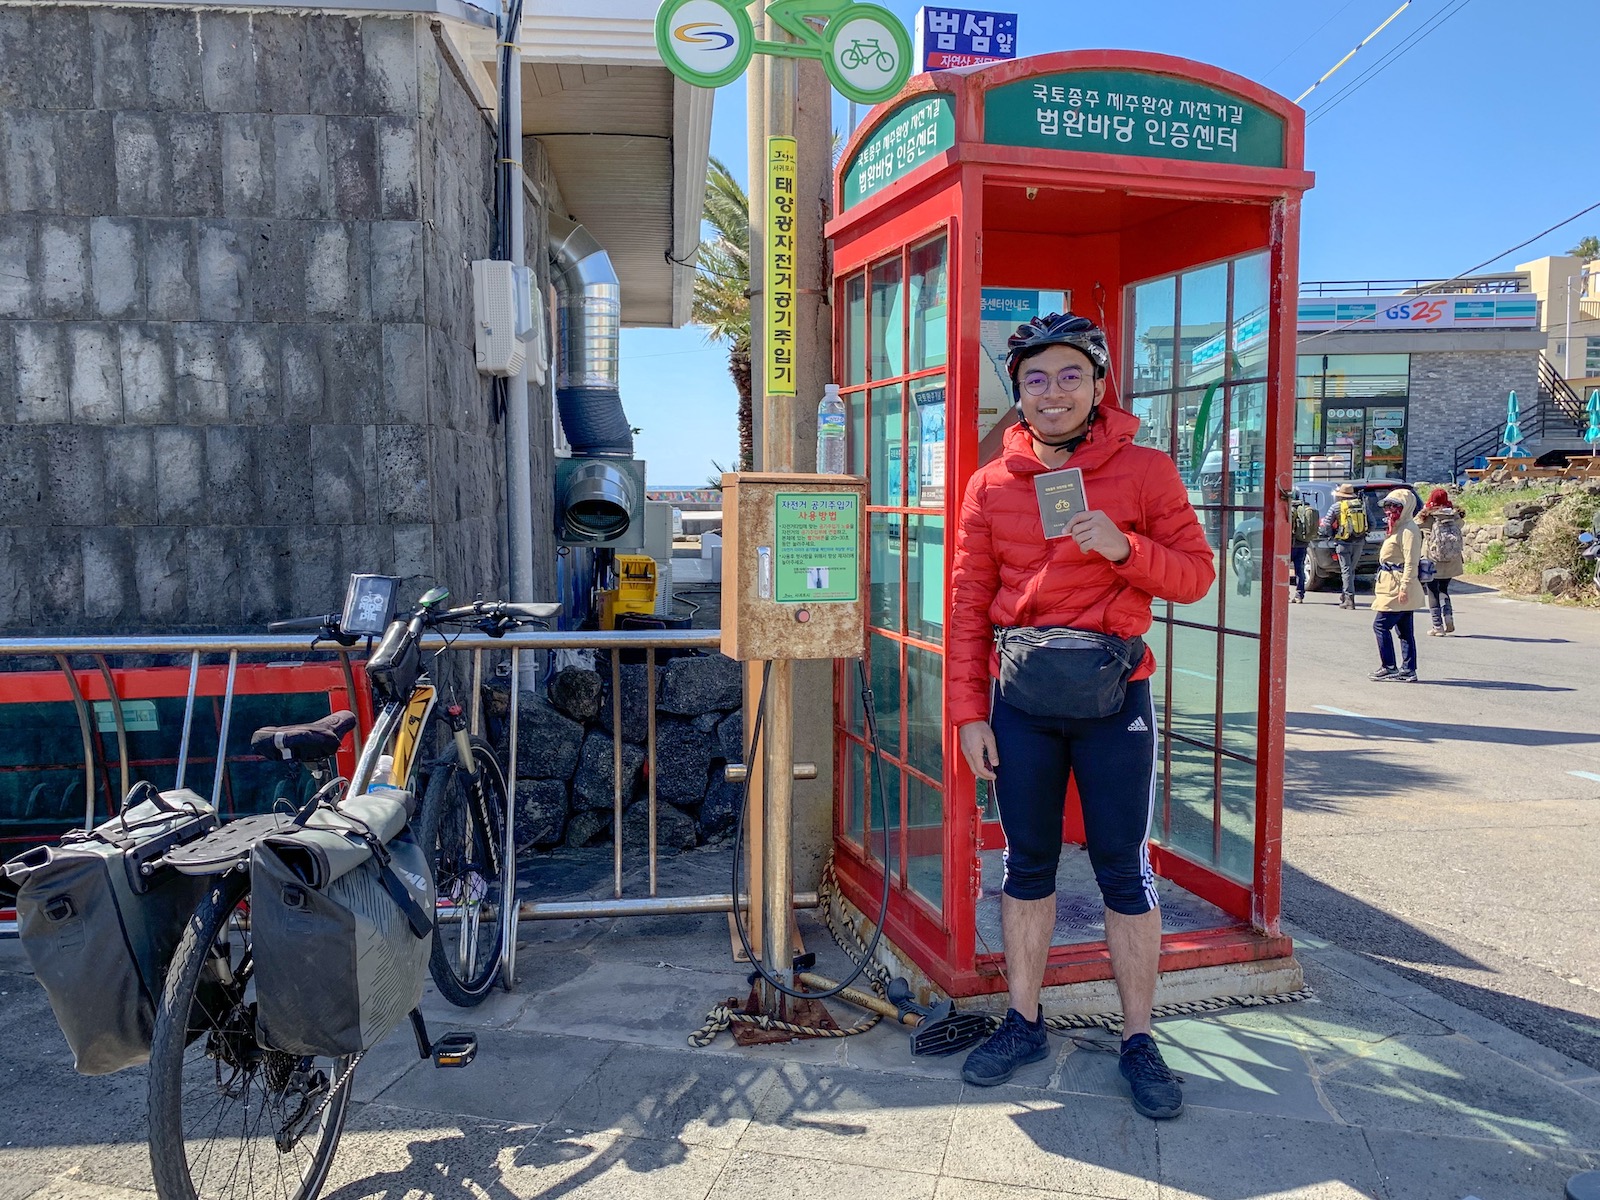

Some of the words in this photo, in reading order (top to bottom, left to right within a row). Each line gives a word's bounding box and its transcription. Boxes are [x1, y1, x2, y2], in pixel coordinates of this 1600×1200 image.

[928, 10, 995, 53] 범섬
[996, 33, 1014, 53] 앞
[1032, 83, 1100, 108] 국토종주
[1106, 91, 1174, 117] 제주환상
[1179, 100, 1243, 125] 자전거길
[1036, 108, 1136, 143] 법환바당
[1144, 119, 1238, 152] 인증센터
[858, 151, 894, 194] 법환바당
[896, 122, 937, 169] 인증센터
[1328, 409, 1363, 418] OPEN
[781, 501, 807, 510] 자전거
[811, 501, 853, 510] 공기주입기
[799, 511, 837, 521] 사용방법
